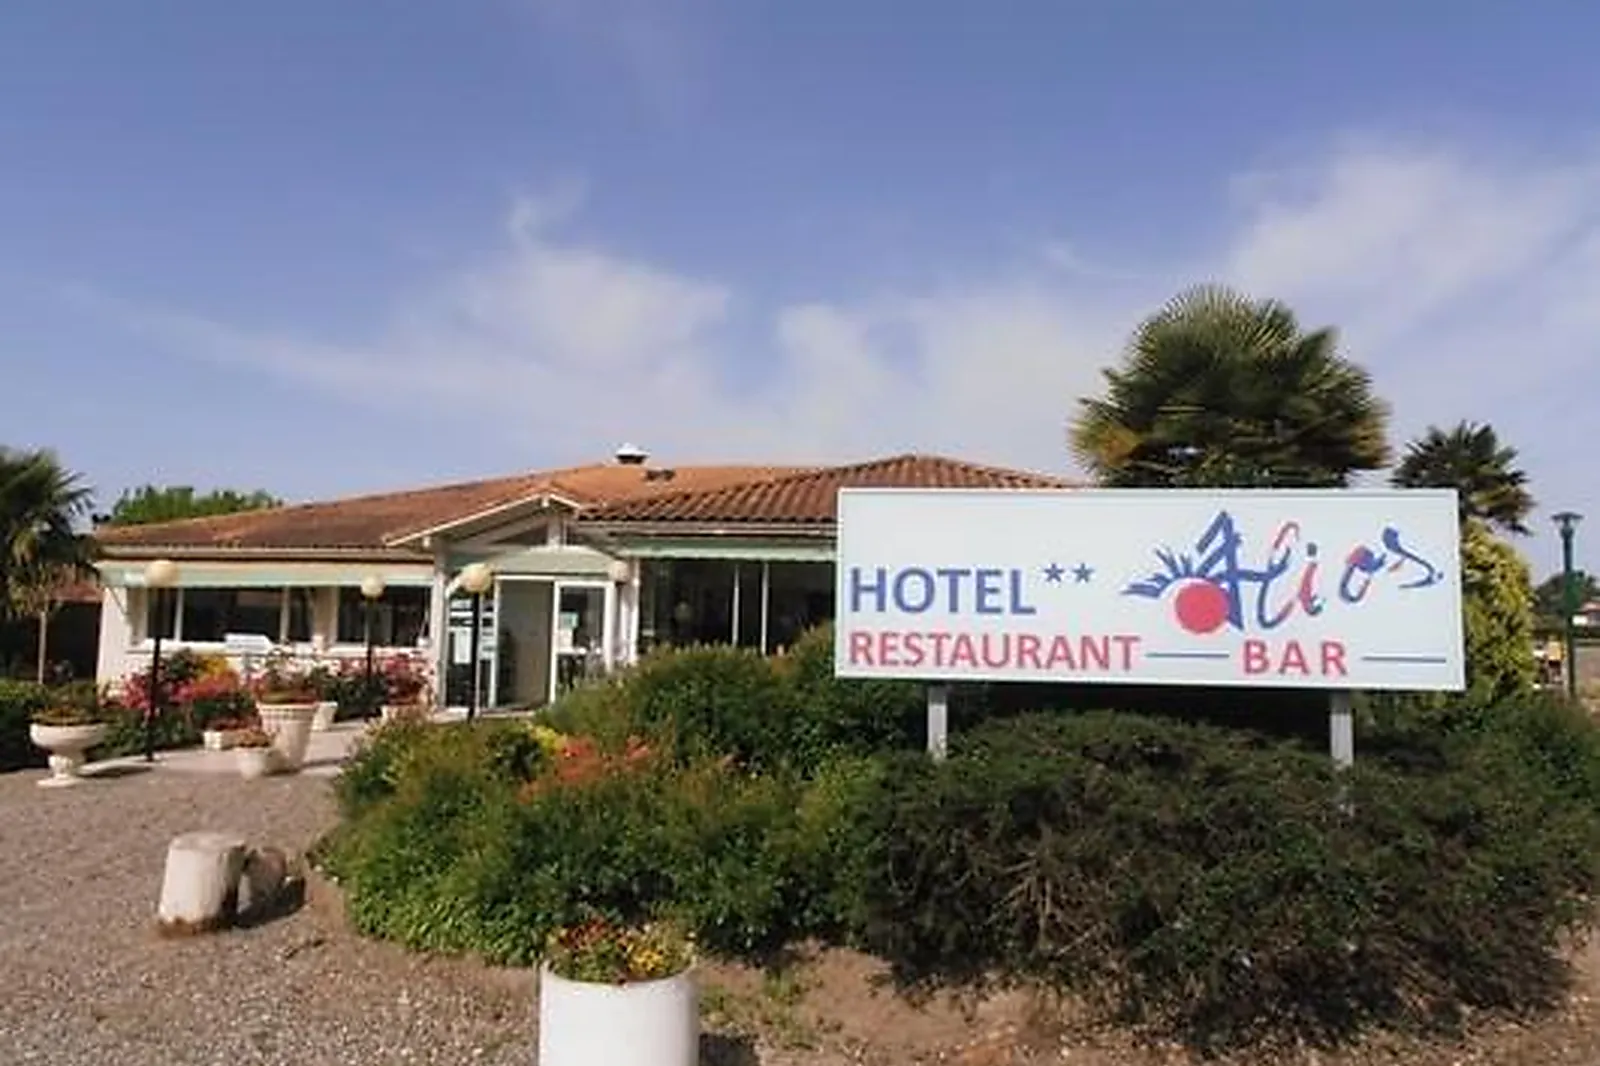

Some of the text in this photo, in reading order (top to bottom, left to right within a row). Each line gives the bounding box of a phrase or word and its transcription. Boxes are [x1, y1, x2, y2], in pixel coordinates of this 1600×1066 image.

[849, 566, 1037, 616] HOTEL
[849, 631, 1349, 677] RESTAURANT BAR
